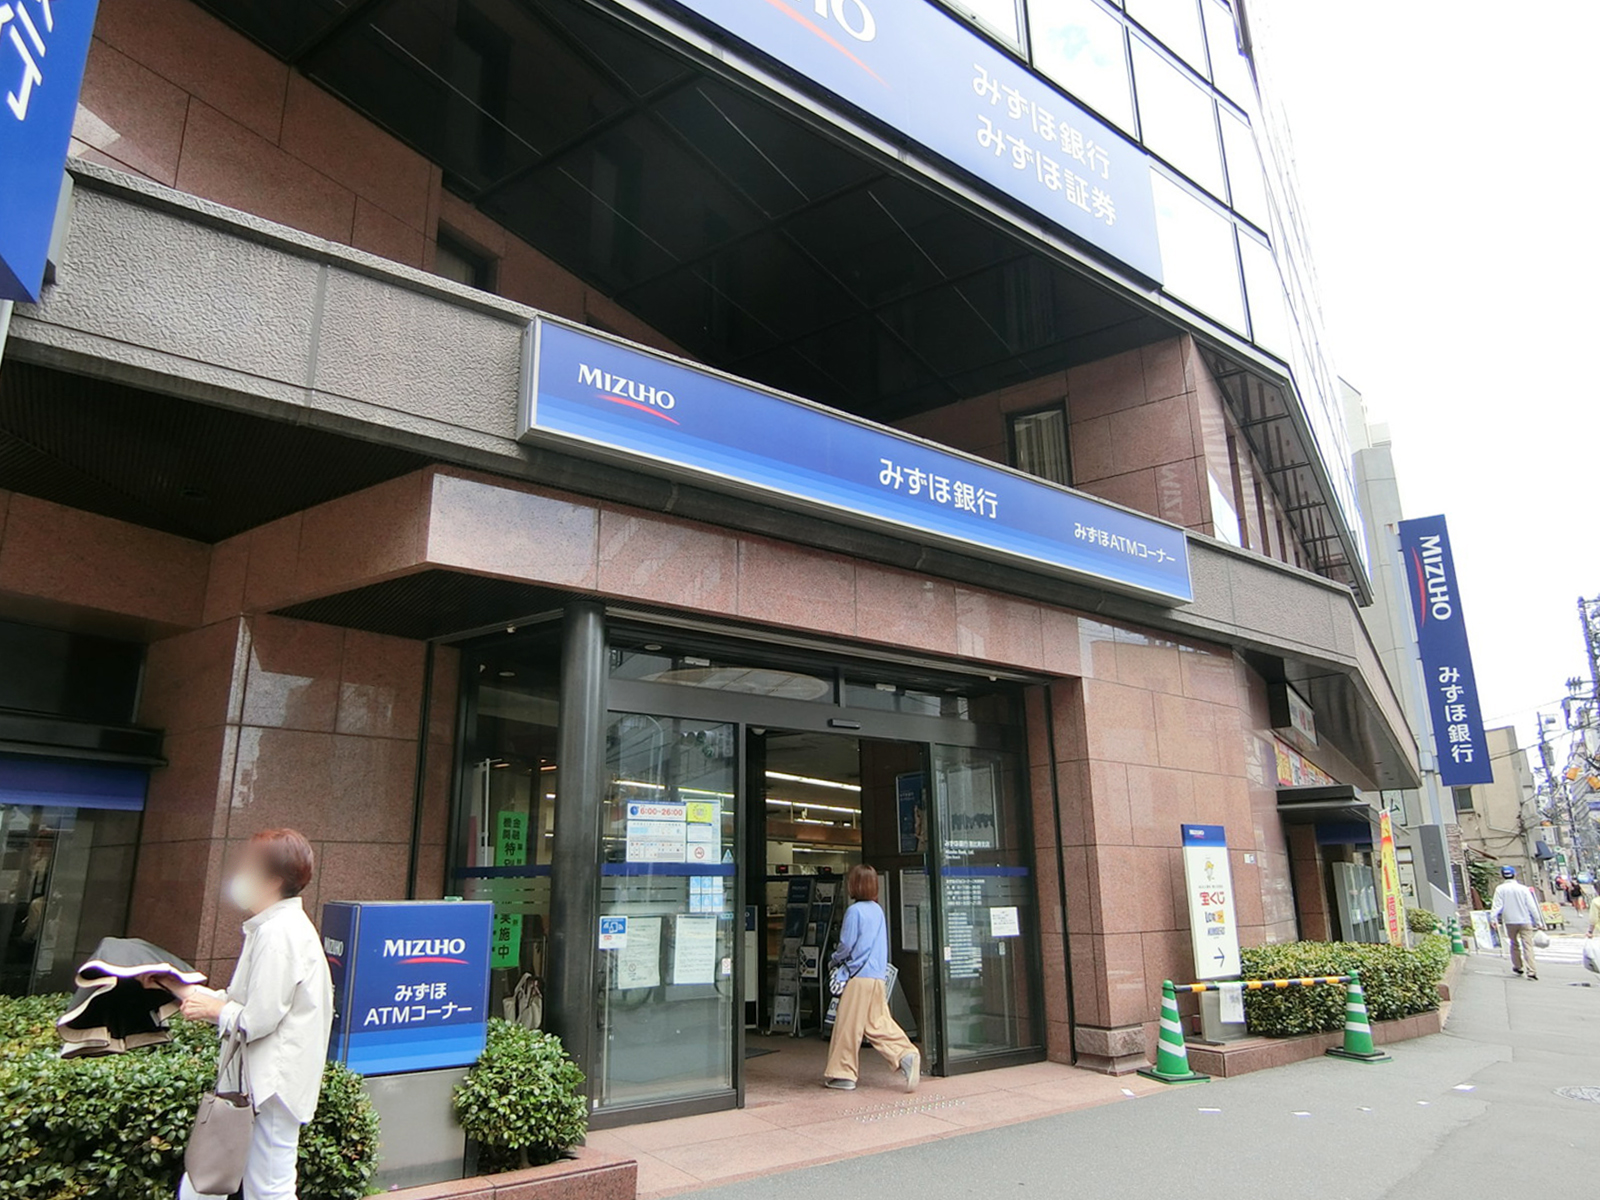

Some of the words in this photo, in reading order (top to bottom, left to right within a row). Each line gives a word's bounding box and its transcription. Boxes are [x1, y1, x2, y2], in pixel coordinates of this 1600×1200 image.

[972, 63, 1110, 180] みずほ銀行
[977, 113, 1118, 226] みずほ証券
[577, 363, 676, 411] MIZUHO
[879, 457, 999, 521] みずほ銀行
[1073, 521, 1177, 564] みずほATMコーナー
[1419, 534, 1452, 621] MIZUHO
[1438, 666, 1475, 763] みずほ銀行
[1199, 891, 1225, 906] 宝くじ
[383, 938, 466, 958] MIZUHO
[364, 1002, 473, 1027] ATMコーナー
[394, 982, 448, 1002] みずほ
